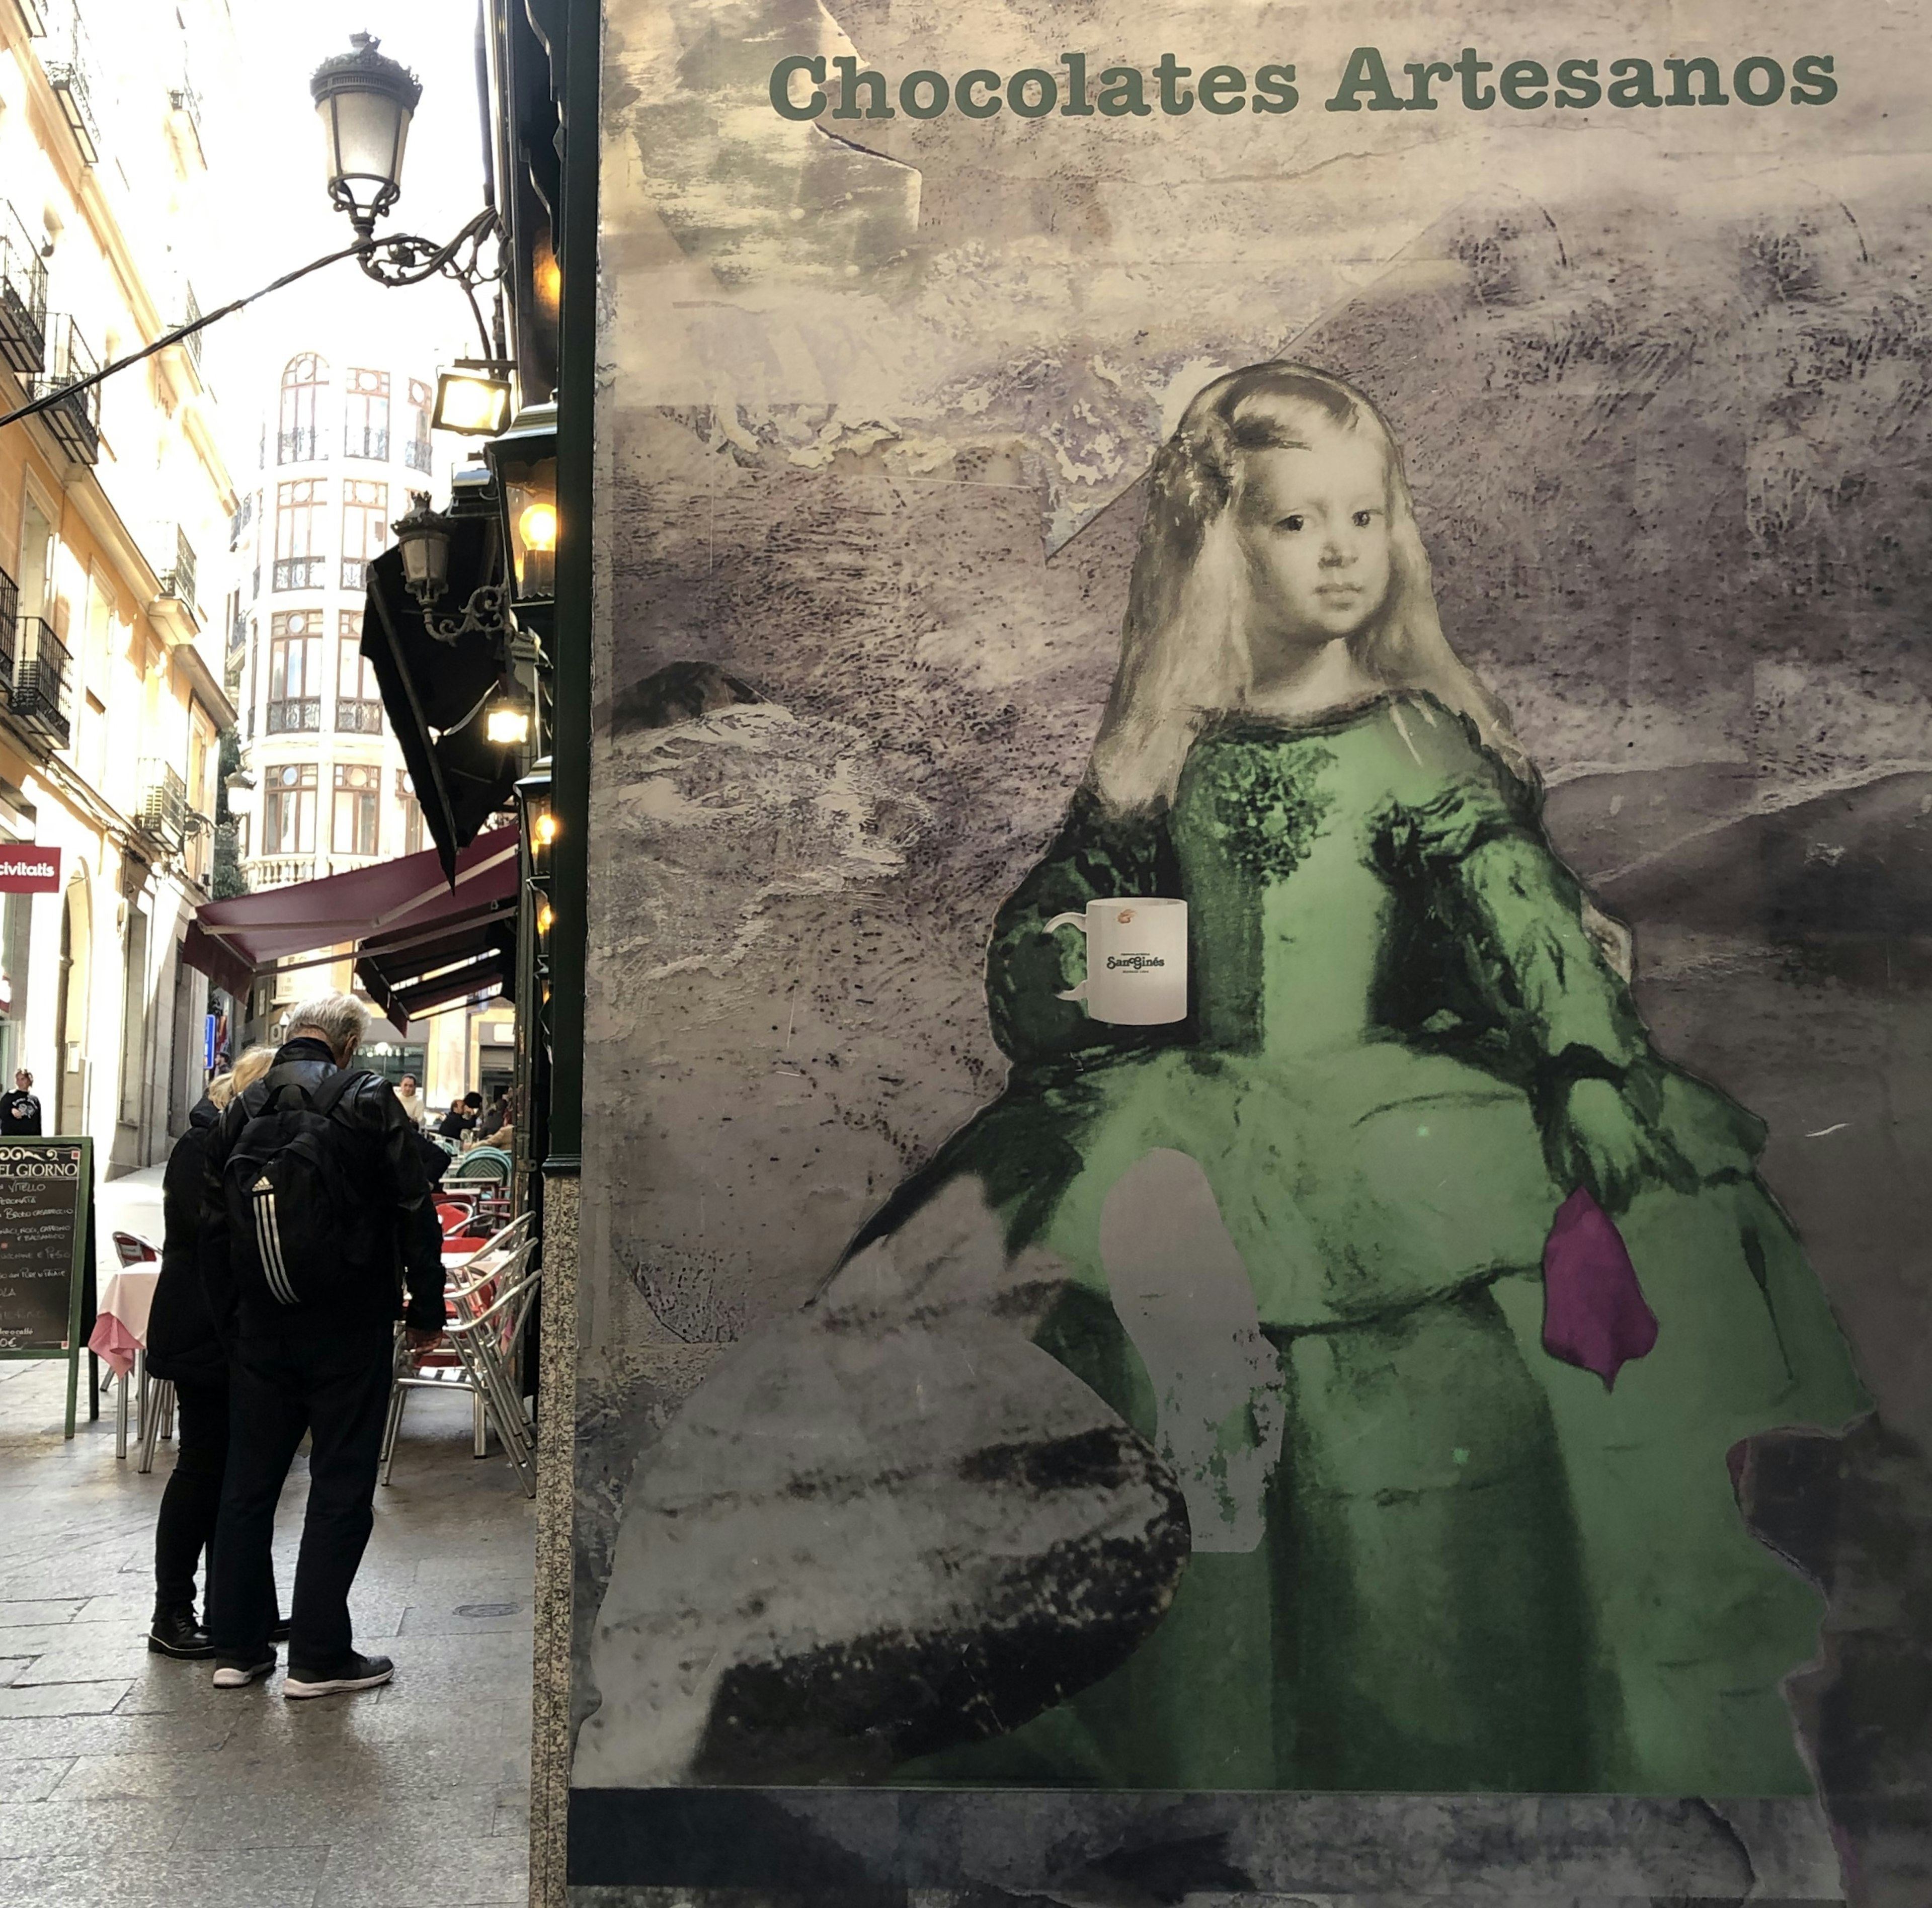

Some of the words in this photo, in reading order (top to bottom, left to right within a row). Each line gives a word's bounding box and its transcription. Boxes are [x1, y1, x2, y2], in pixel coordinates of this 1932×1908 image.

[769, 53, 1300, 121] Chocolates
[1325, 47, 1838, 111] Artesanos
[0, 861, 54, 877] civitatis
[16, 1163, 78, 1176] GIORNO
